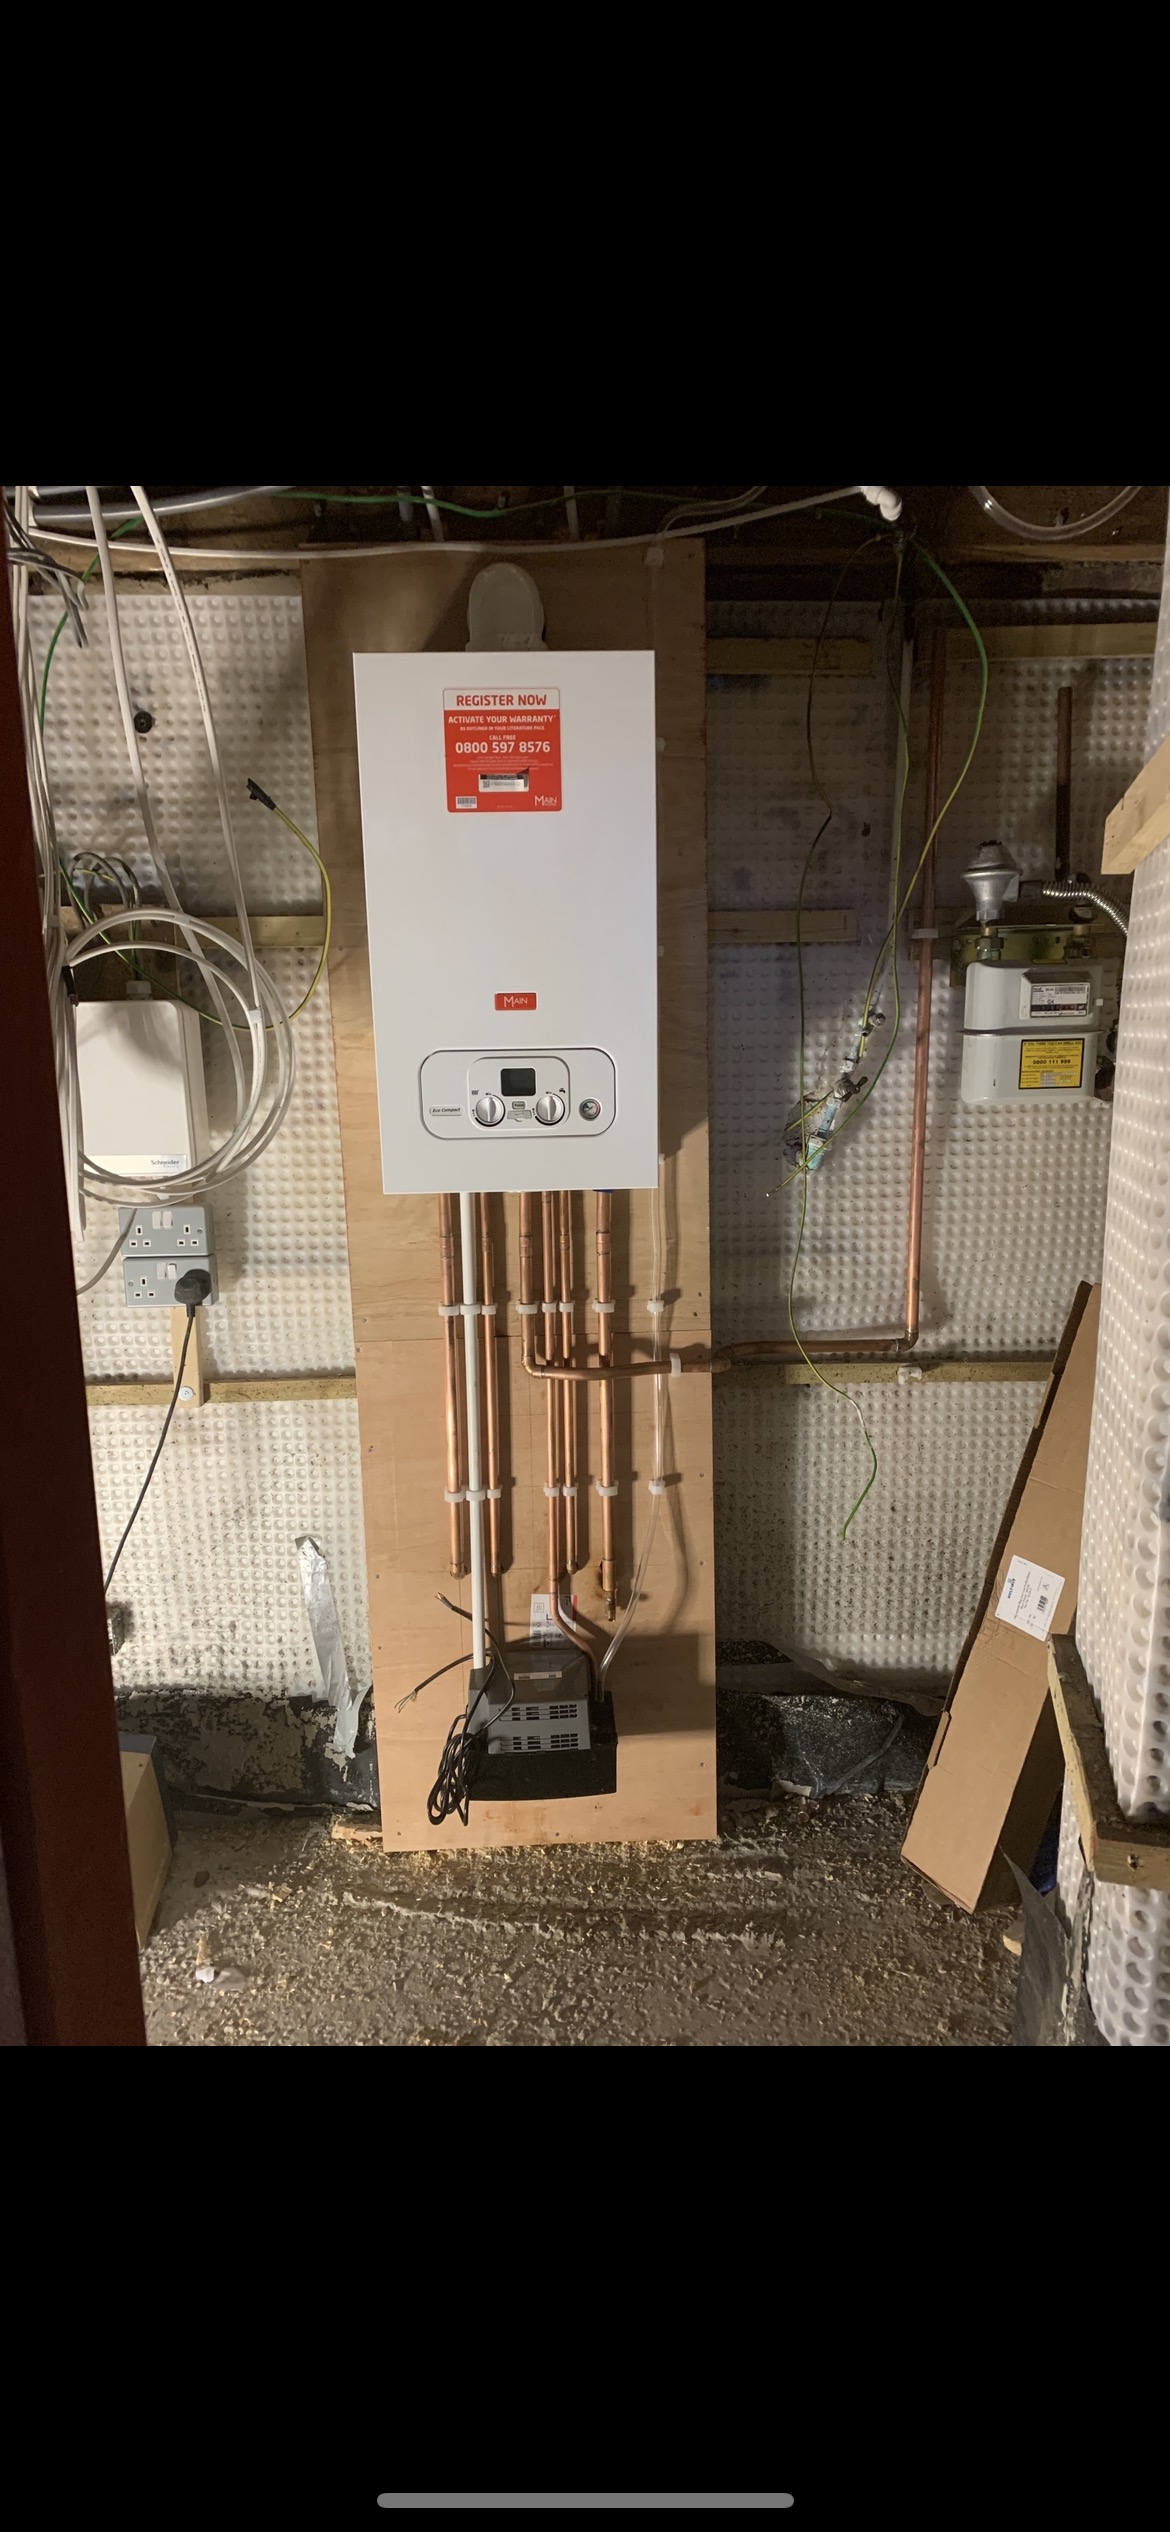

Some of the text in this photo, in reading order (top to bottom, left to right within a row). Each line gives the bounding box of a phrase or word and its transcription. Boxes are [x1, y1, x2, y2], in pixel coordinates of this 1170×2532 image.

[456, 694, 547, 706] REGISTER NOW
[448, 715, 484, 724] ACTIVATE
[486, 715, 508, 723] YOUR
[455, 741, 551, 753] 0800 597 8576
